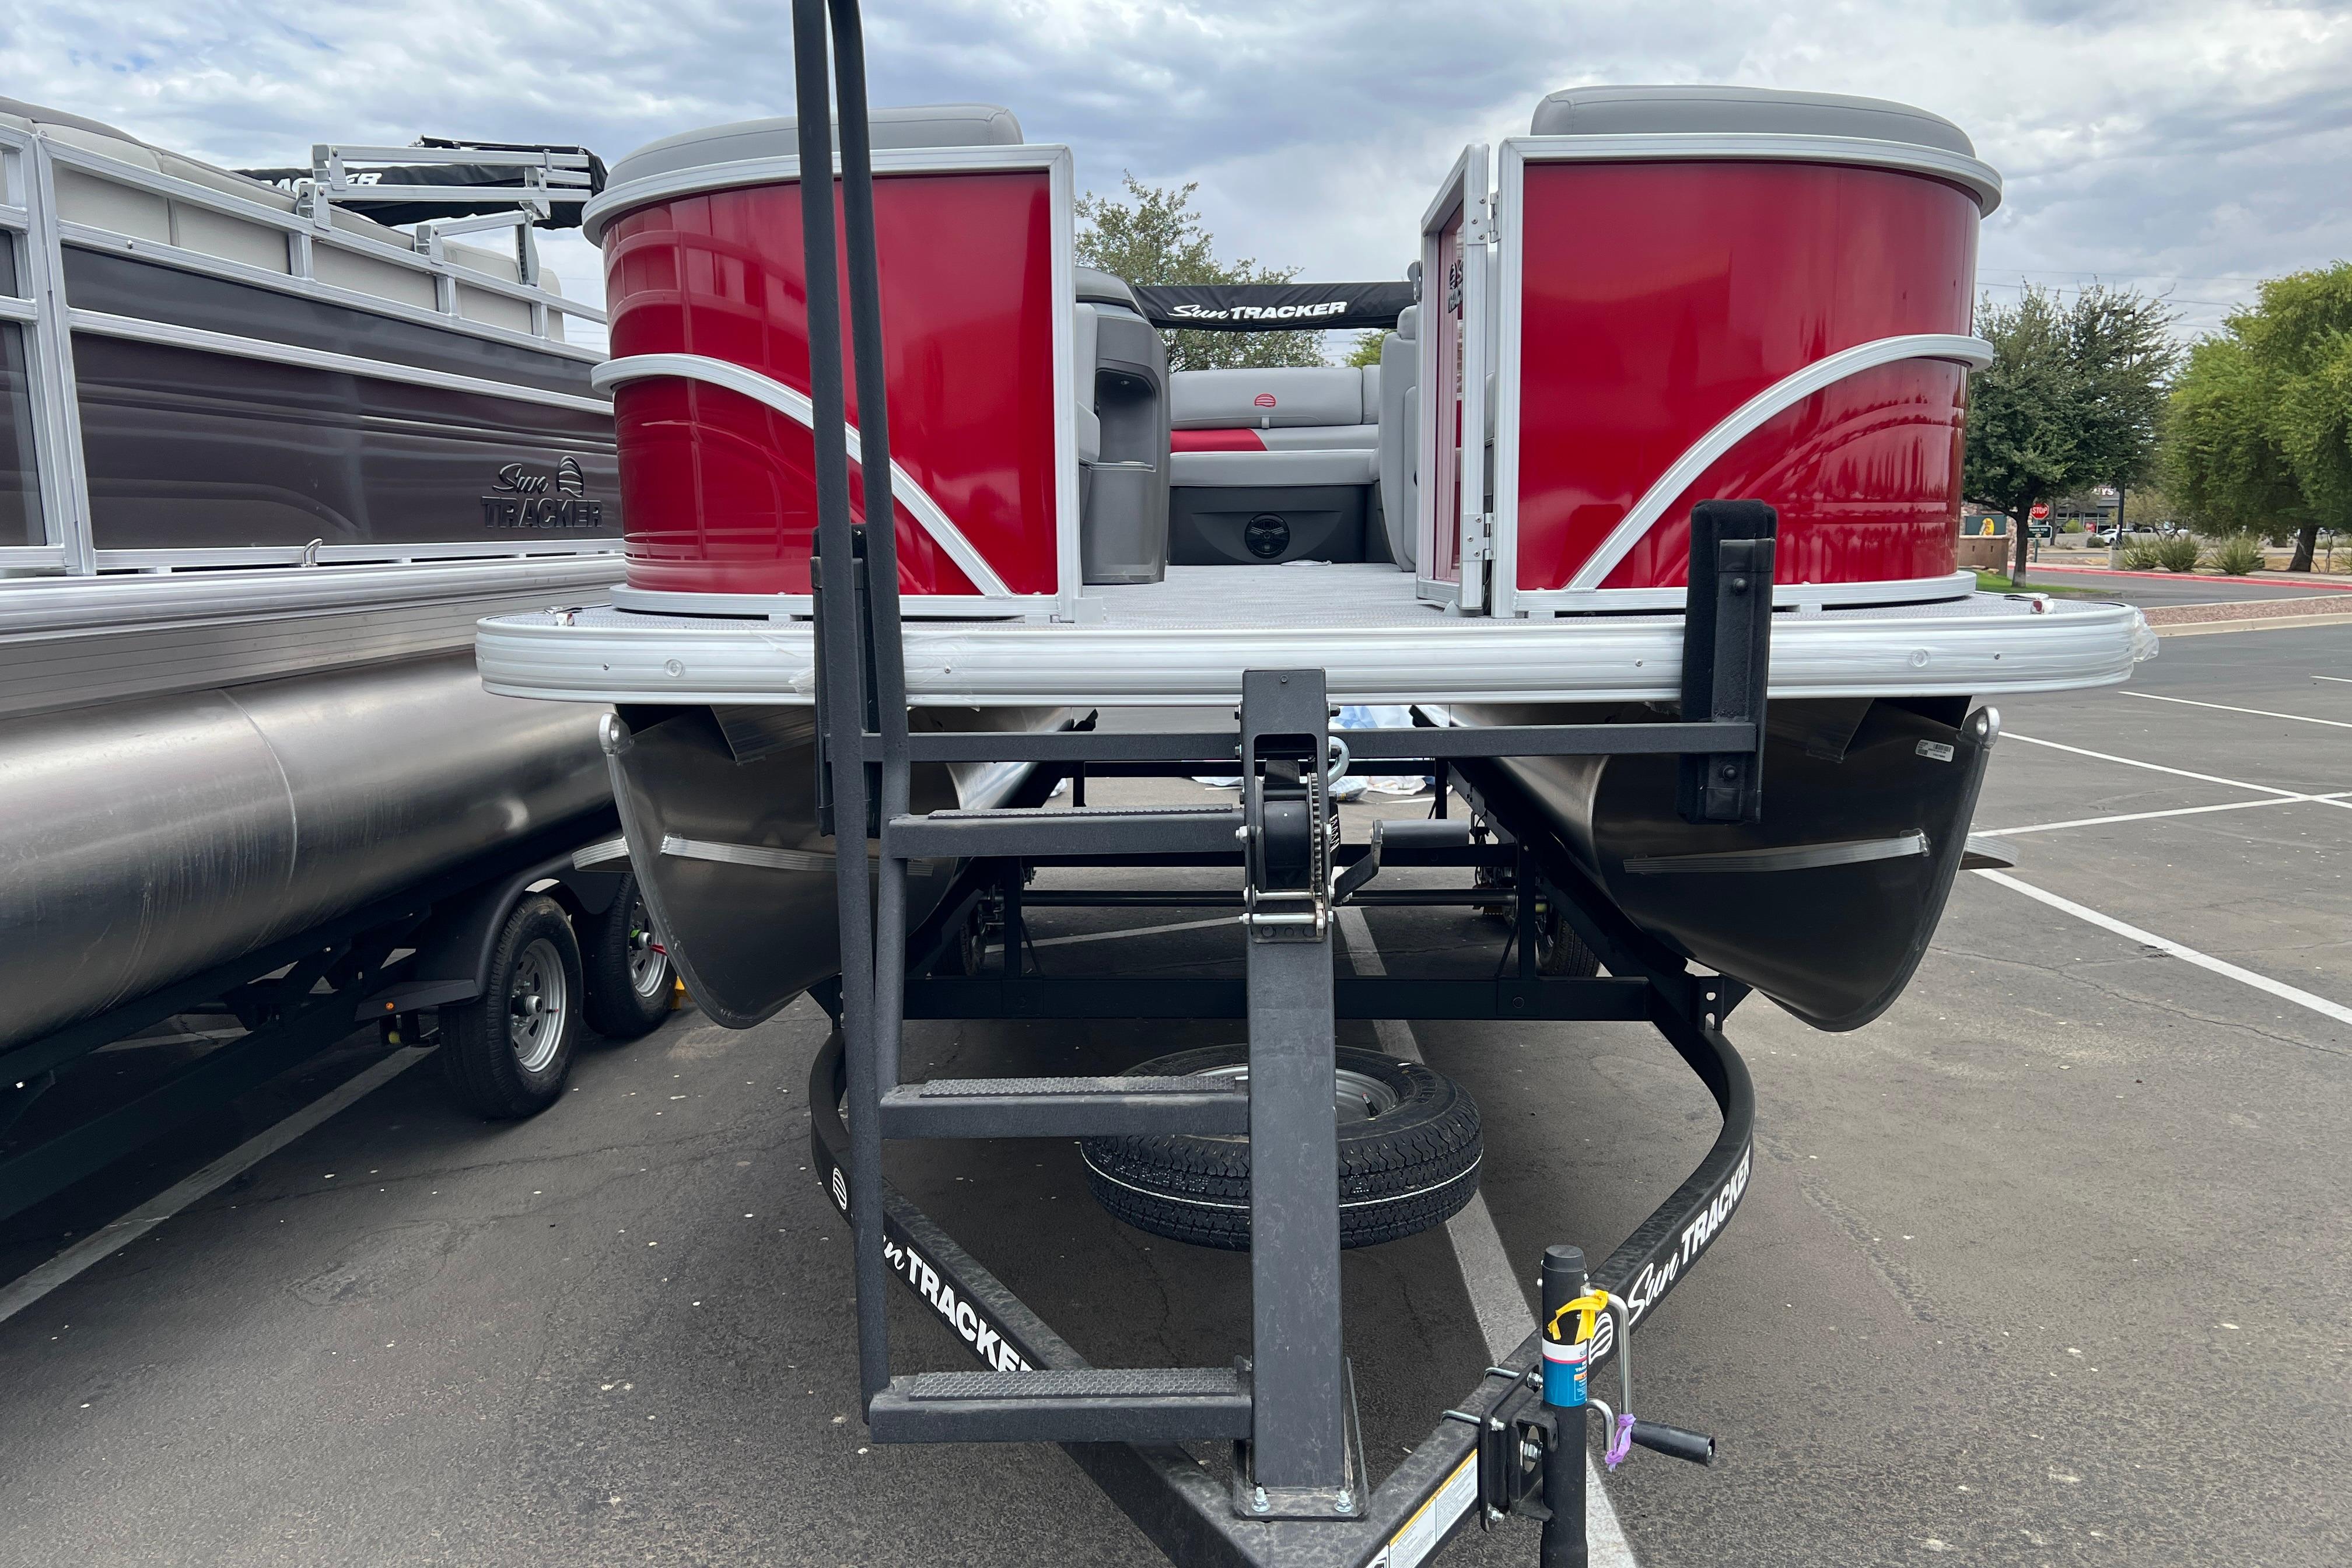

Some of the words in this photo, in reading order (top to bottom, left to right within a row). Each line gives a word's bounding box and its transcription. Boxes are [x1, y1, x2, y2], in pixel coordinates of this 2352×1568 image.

[1167, 304, 1230, 319] Sun
[1230, 301, 1348, 320] TRACKER
[492, 463, 549, 495] Sun
[481, 496, 603, 528] TRACKER
[1628, 1252, 1679, 1326] Sun
[1681, 1143, 1751, 1265] TRACKER
[907, 1246, 1034, 1372] TRACKE
